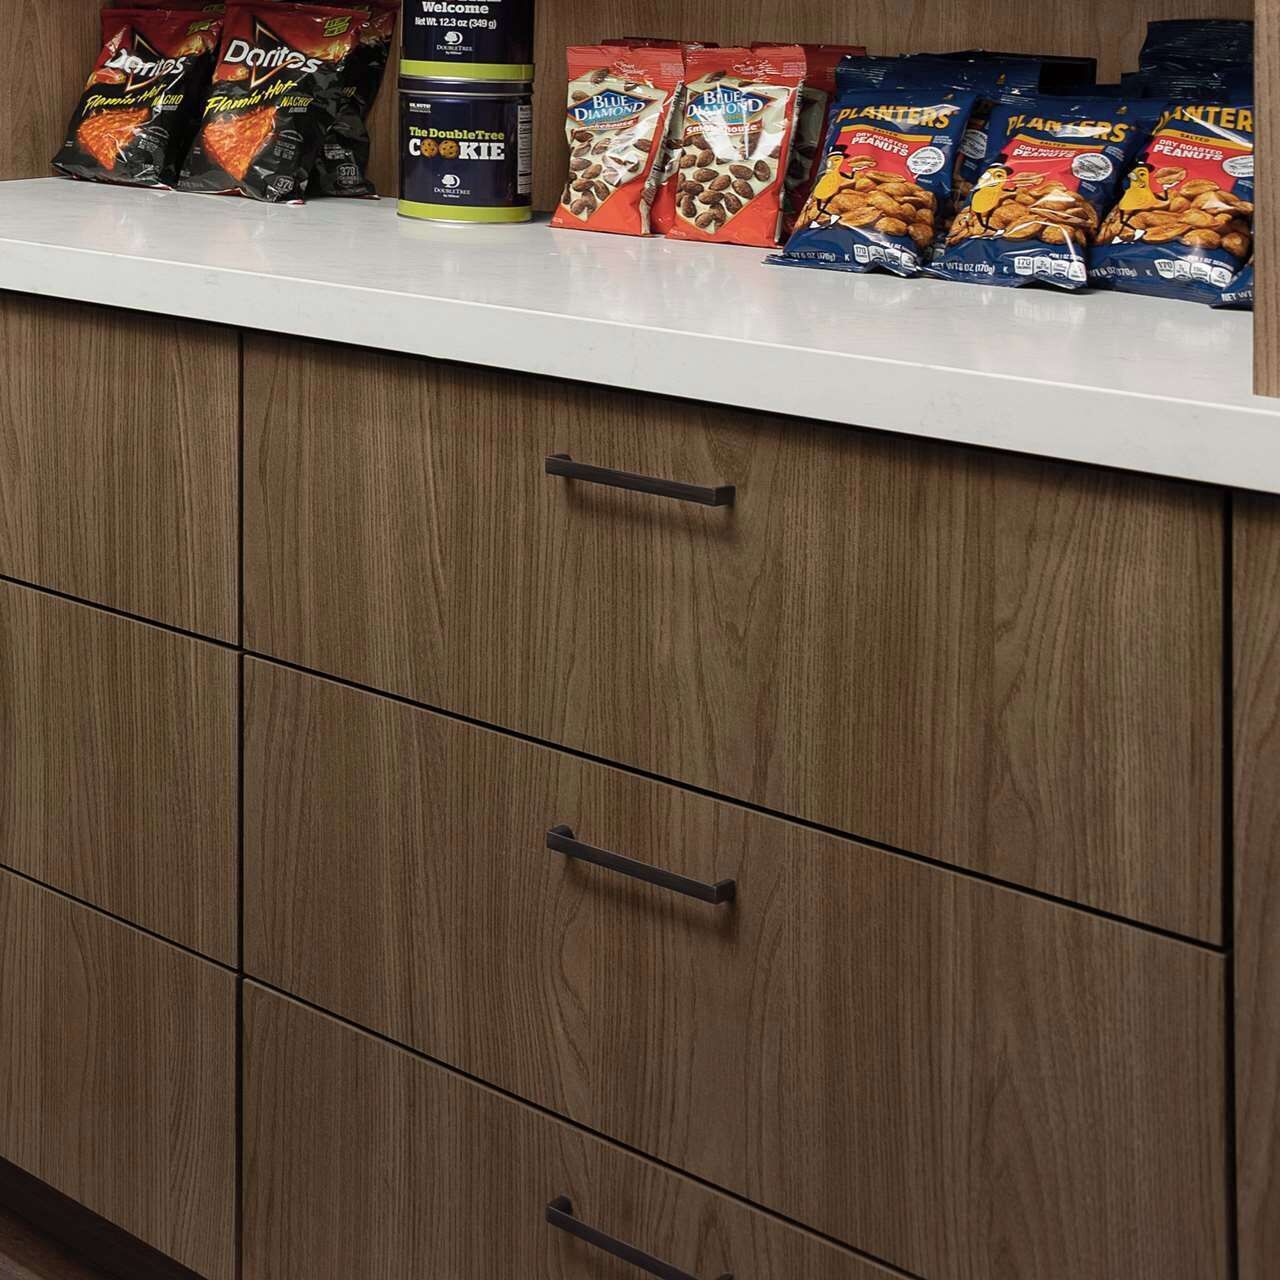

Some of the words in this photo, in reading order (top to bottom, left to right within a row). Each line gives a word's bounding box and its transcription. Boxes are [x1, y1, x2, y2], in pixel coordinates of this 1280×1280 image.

[422, 1, 489, 13] Welcome
[440, 18, 456, 27] 12.3
[469, 19, 487, 28] (349
[105, 48, 185, 78] Doritos
[224, 39, 324, 73] Doritos
[151, 94, 184, 108] NACHO
[203, 89, 262, 119] Flamin'
[264, 79, 298, 99] Hot
[280, 95, 314, 108] NACHO
[593, 95, 629, 109] BLUE
[702, 90, 741, 105] BLUE
[574, 101, 646, 121] DIAMOND
[835, 104, 951, 129] PLANTERS
[409, 126, 428, 137] The
[429, 128, 505, 140] DoubleTree
[851, 137, 909, 157] PEANUTS
[874, 135, 909, 149] ROASTED
[1160, 139, 1179, 147] DRY
[1179, 143, 1223, 155] ROASTED
[1012, 148, 1076, 158] PEANUTS
[1153, 144, 1224, 160] PEANUTS
[1221, 293, 1237, 302] NET
